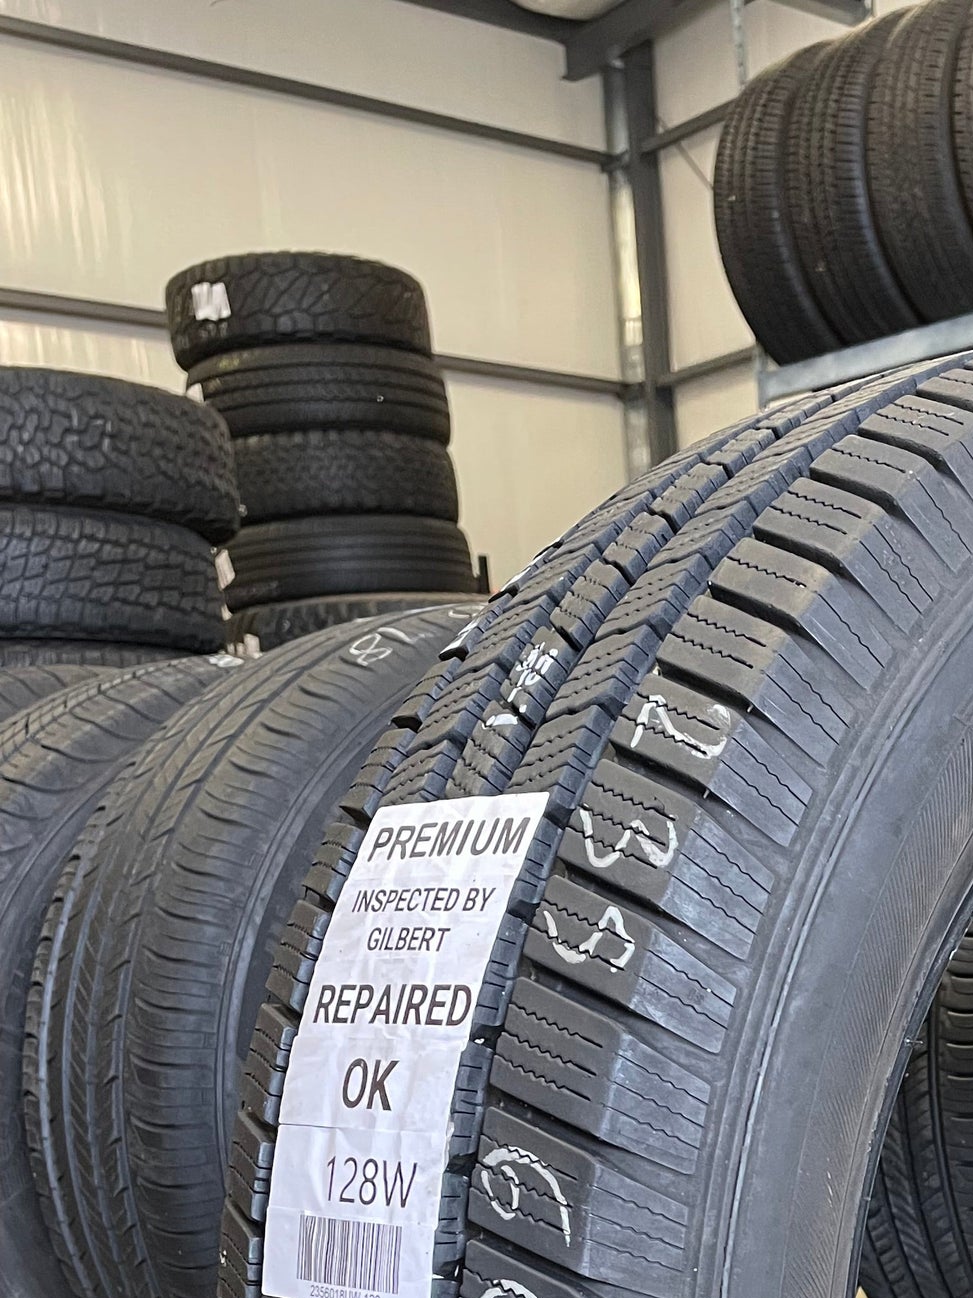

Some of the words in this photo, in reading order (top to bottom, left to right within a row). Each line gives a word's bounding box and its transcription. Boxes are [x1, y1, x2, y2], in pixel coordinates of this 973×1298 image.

[367, 816, 531, 863] PREMIUM
[351, 887, 459, 914] INSPECTED
[463, 886, 496, 912] BY
[366, 926, 452, 952] GILBERT
[313, 983, 473, 1027] REPAIRED
[341, 1057, 400, 1112] OK
[326, 1155, 417, 1209] 128W
